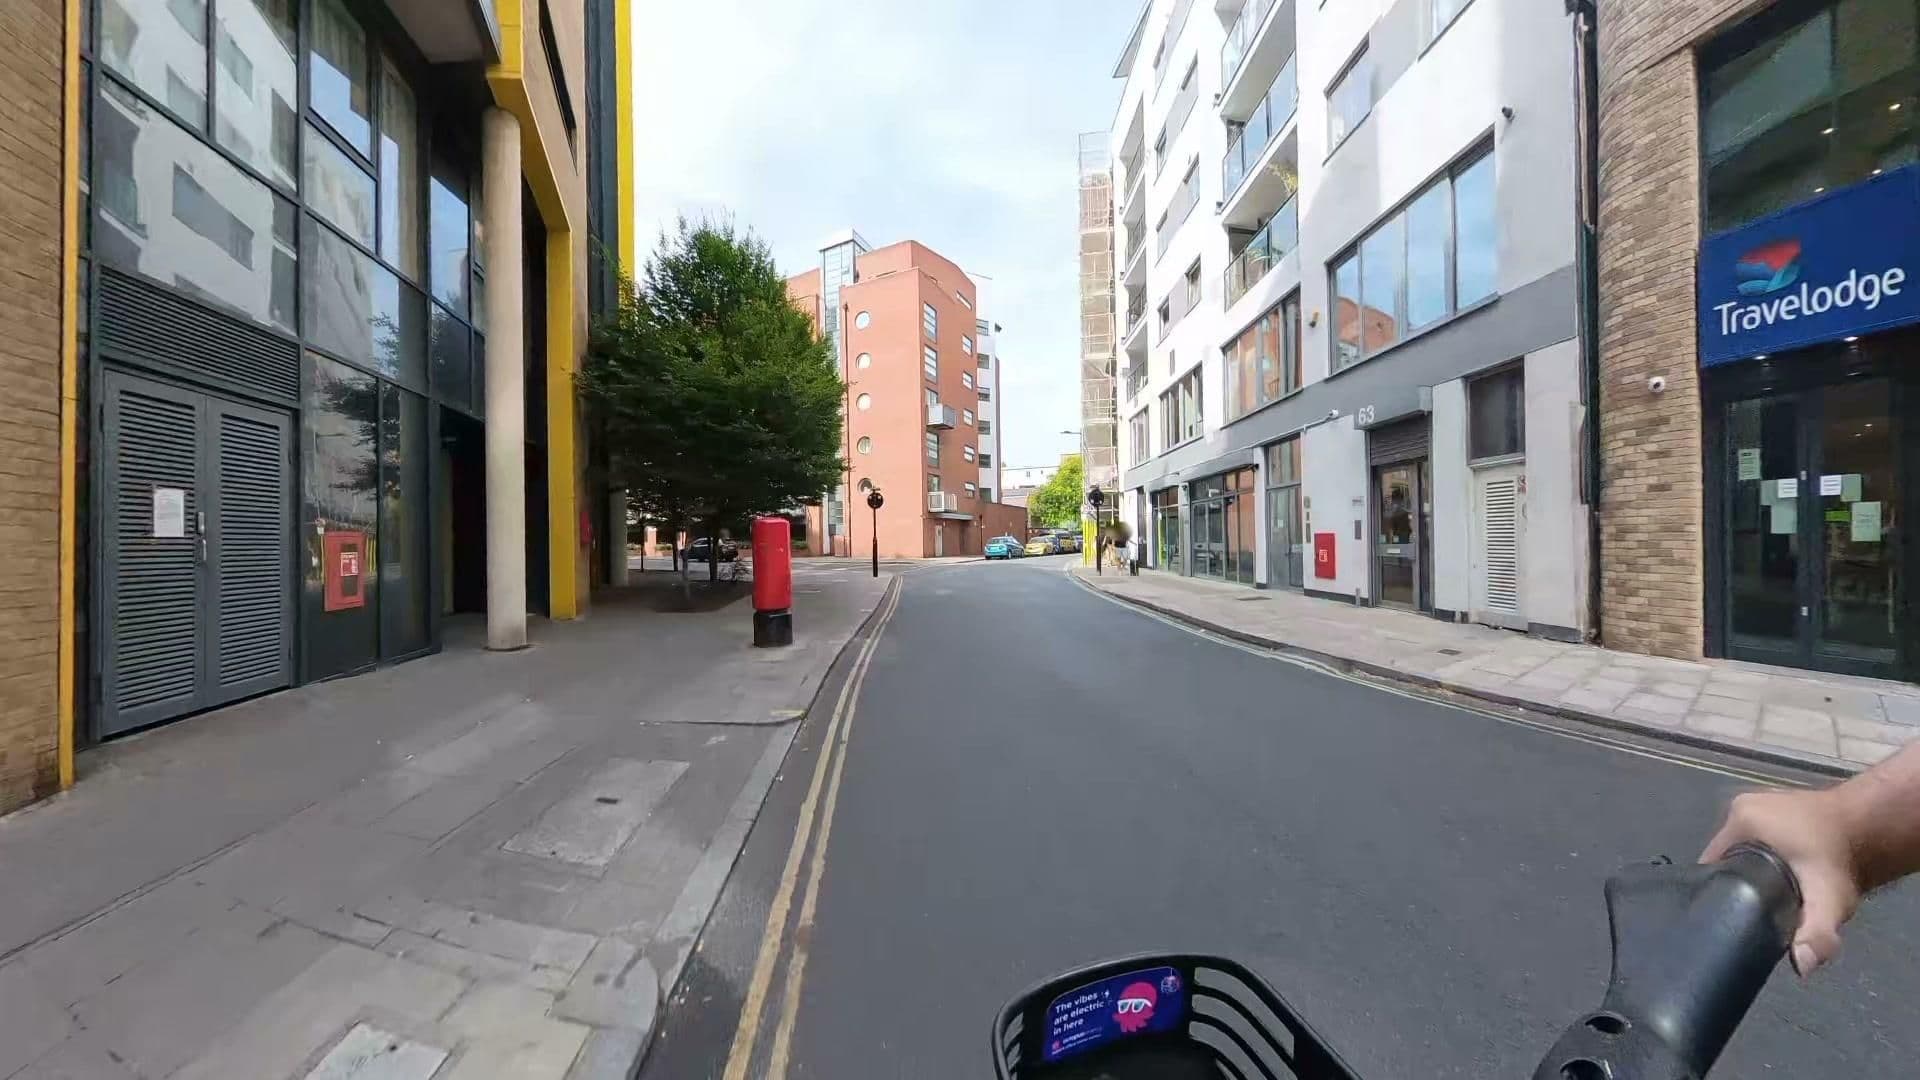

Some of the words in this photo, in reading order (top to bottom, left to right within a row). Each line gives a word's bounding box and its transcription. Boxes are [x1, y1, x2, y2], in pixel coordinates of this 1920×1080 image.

[1713, 267, 1906, 335] Travelodge
[1358, 404, 1375, 425] 63
[1053, 1013, 1069, 1026] are
[1071, 1000, 1104, 1018] electric
[1055, 1002, 1072, 1014] The
[1074, 993, 1098, 1005] vibes
[1053, 1027, 1062, 1036] in
[1063, 1018, 1084, 1032] here
